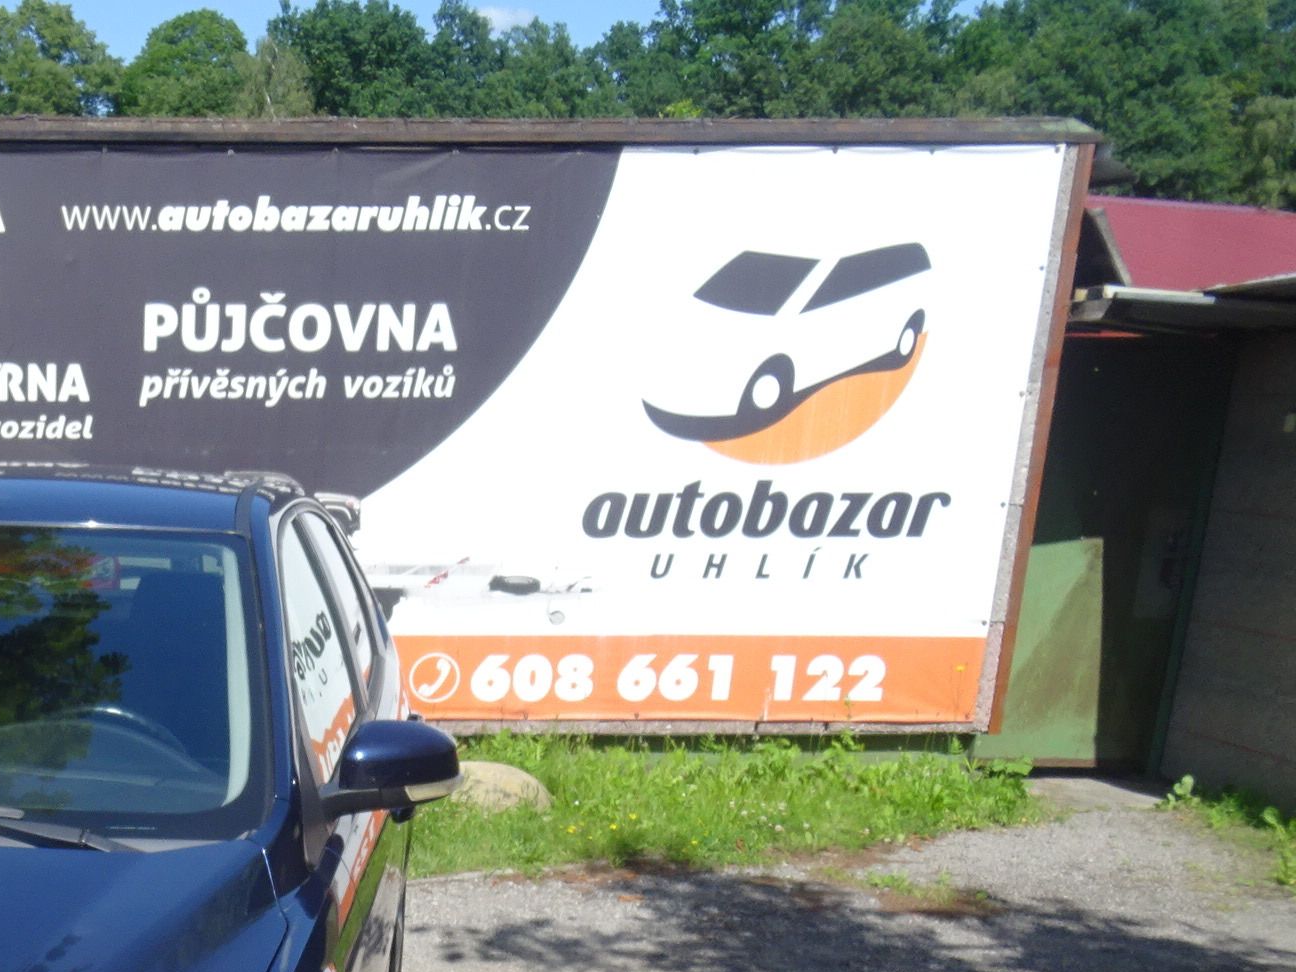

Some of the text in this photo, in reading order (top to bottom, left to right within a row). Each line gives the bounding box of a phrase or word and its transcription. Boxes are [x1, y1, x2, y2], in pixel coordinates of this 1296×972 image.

[61, 194, 532, 232] www.autobazaruhlik.cz
[143, 286, 458, 353] PŮJČOVNA
[139, 364, 456, 407] přívěsných vozíků
[582, 479, 952, 539] autobazar
[650, 546, 869, 580] UHLÍK
[470, 653, 887, 704] 608 661 122
